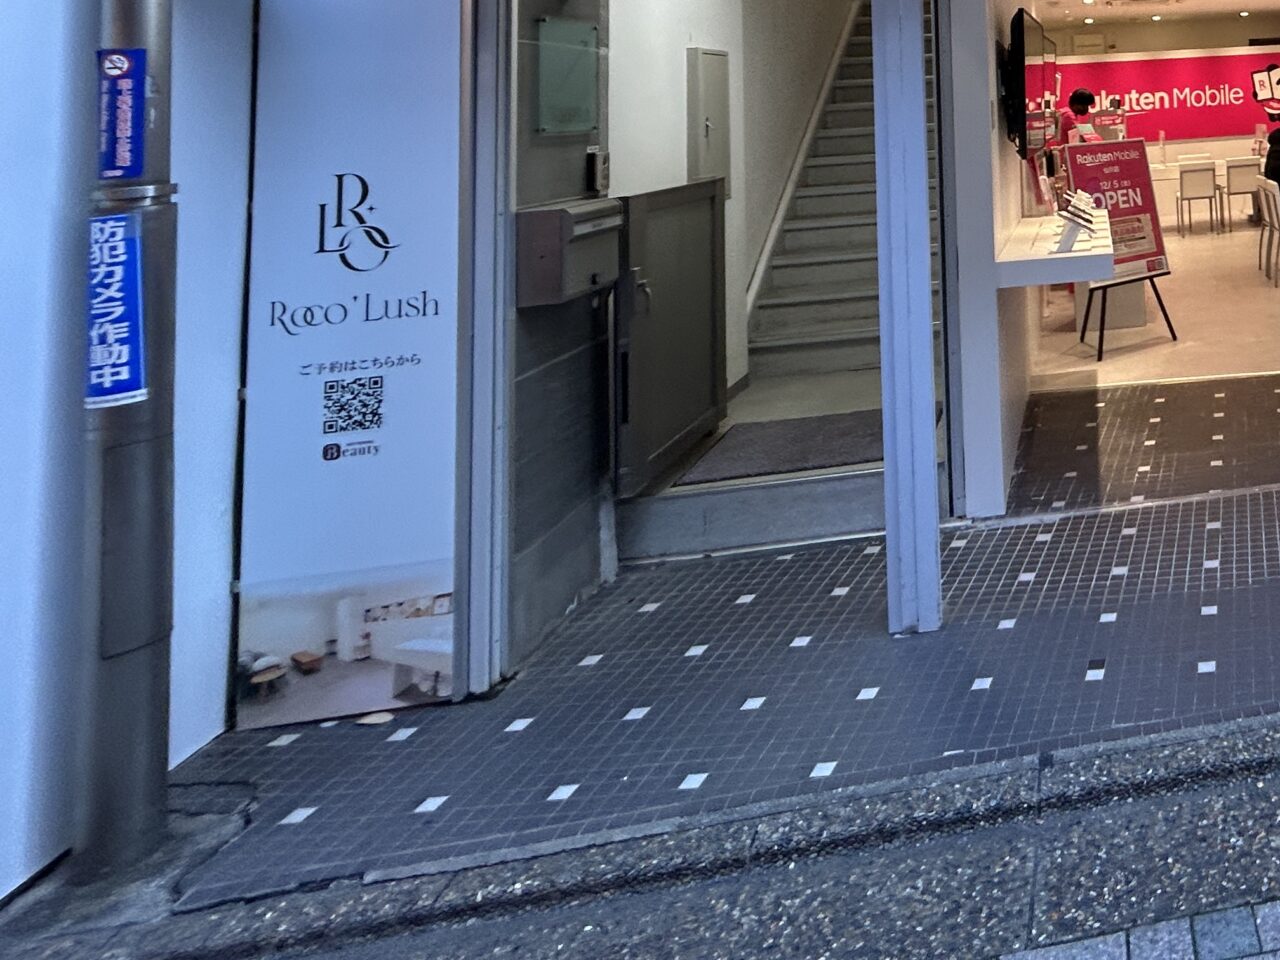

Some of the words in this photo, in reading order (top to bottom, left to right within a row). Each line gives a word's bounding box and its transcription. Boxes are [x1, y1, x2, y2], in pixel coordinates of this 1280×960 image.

[1173, 82, 1244, 109] Mobile
[1076, 152, 1115, 166] Rakuten
[1092, 187, 1143, 211] OPEN
[88, 220, 130, 389] 防犯カメラ作動中
[299, 353, 422, 376] ご予約はこちらから
